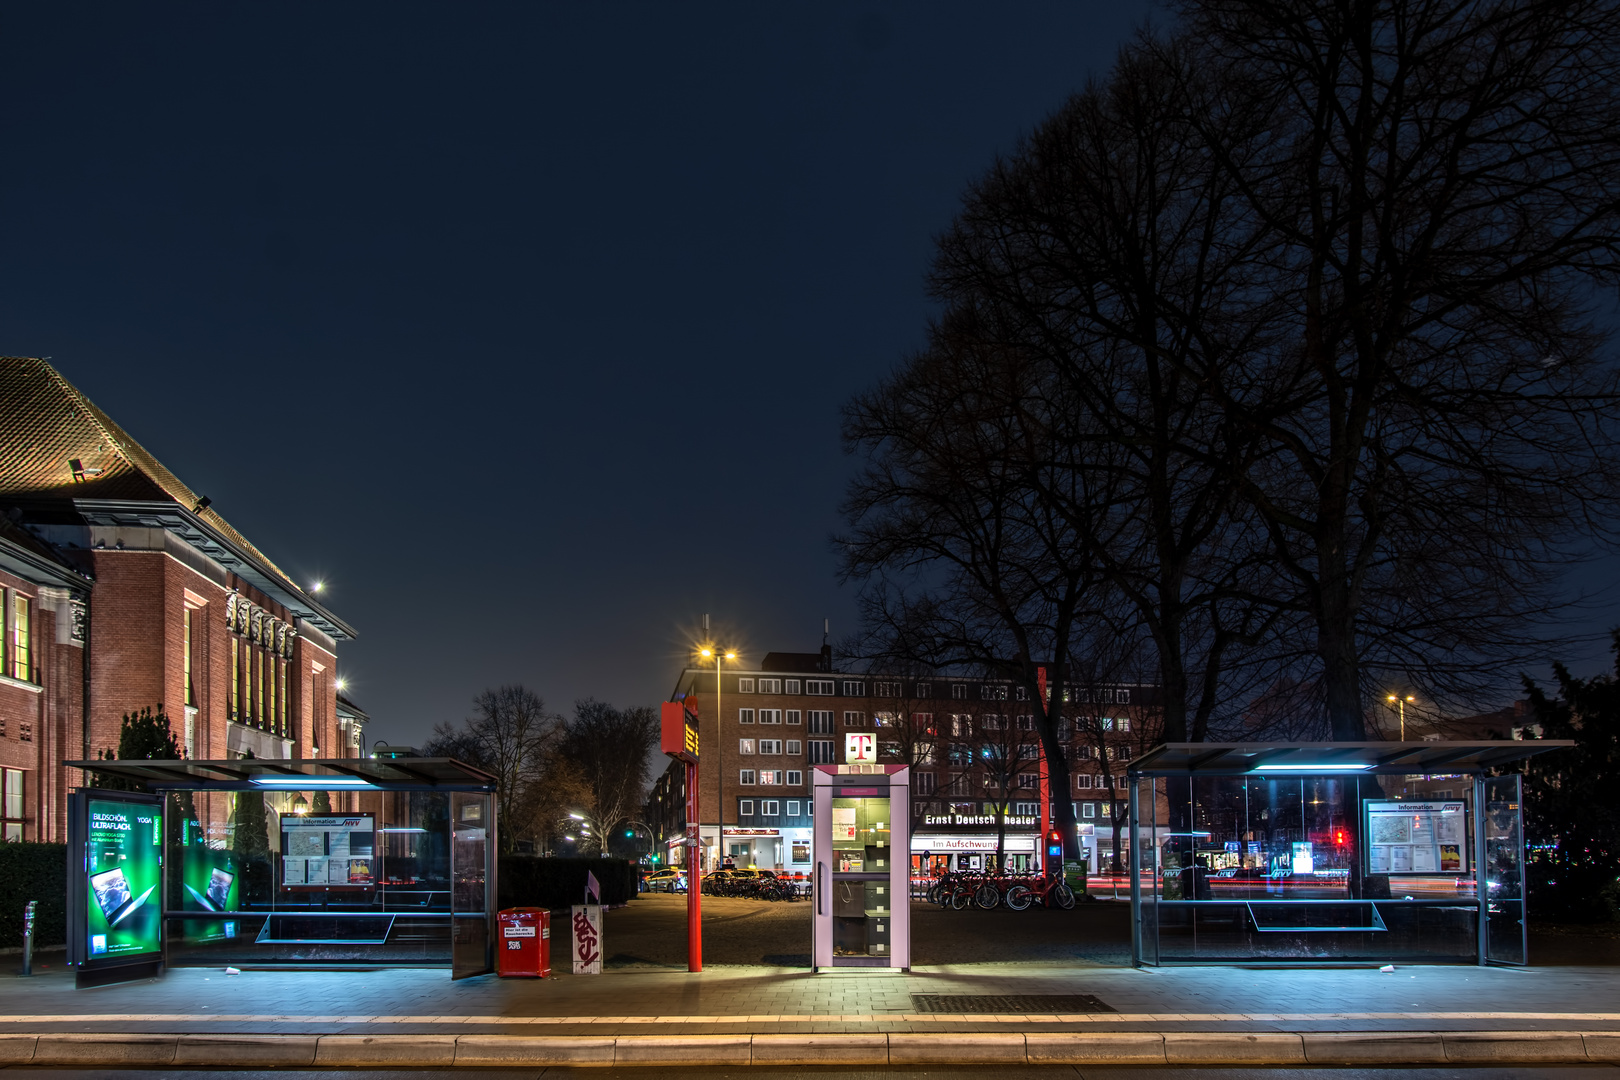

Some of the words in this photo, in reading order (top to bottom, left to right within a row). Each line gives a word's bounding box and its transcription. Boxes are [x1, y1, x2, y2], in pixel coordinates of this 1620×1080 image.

[850, 735, 872, 760] T
[93, 813, 127, 823] BILDSCHÖN.
[136, 816, 152, 824] YOGA
[925, 815, 952, 825] Ernst
[956, 815, 995, 825] Deutsch
[1004, 816, 1035, 825] heater
[92, 821, 131, 831] ULTRAFLACH.
[933, 840, 943, 848] Im
[946, 840, 998, 849] Aufschwung
